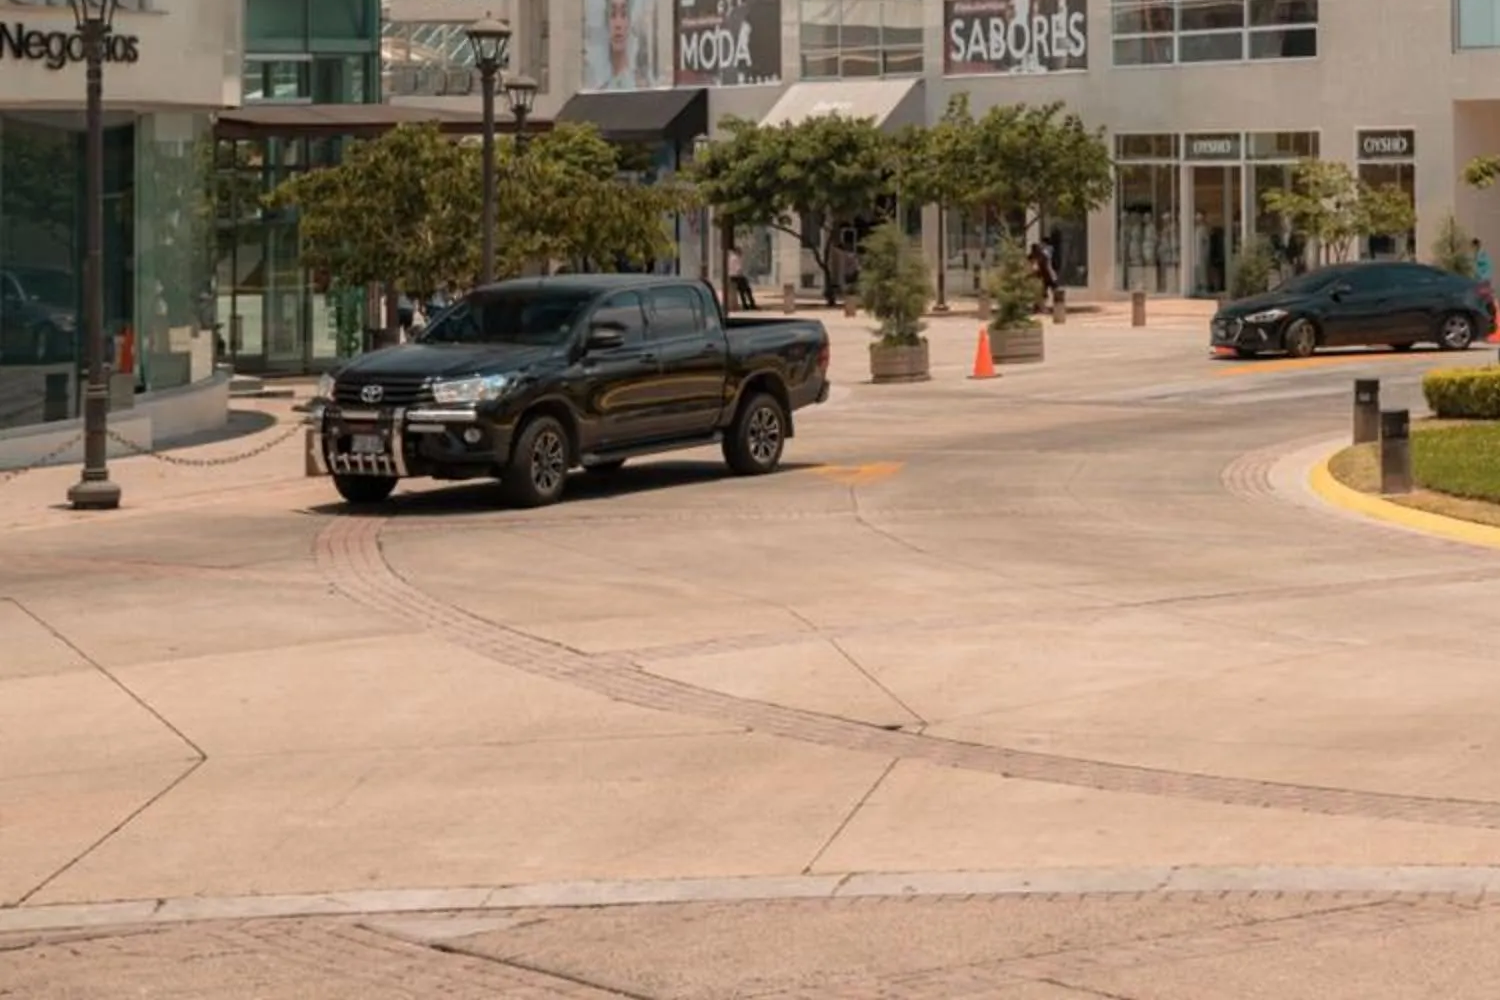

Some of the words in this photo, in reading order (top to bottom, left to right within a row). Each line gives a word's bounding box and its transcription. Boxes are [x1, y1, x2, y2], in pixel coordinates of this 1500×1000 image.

[0, 21, 139, 70] Negoios
[680, 25, 753, 71] MODA
[950, 11, 1085, 62] SABORES
[1363, 136, 1408, 154] OYSHO
